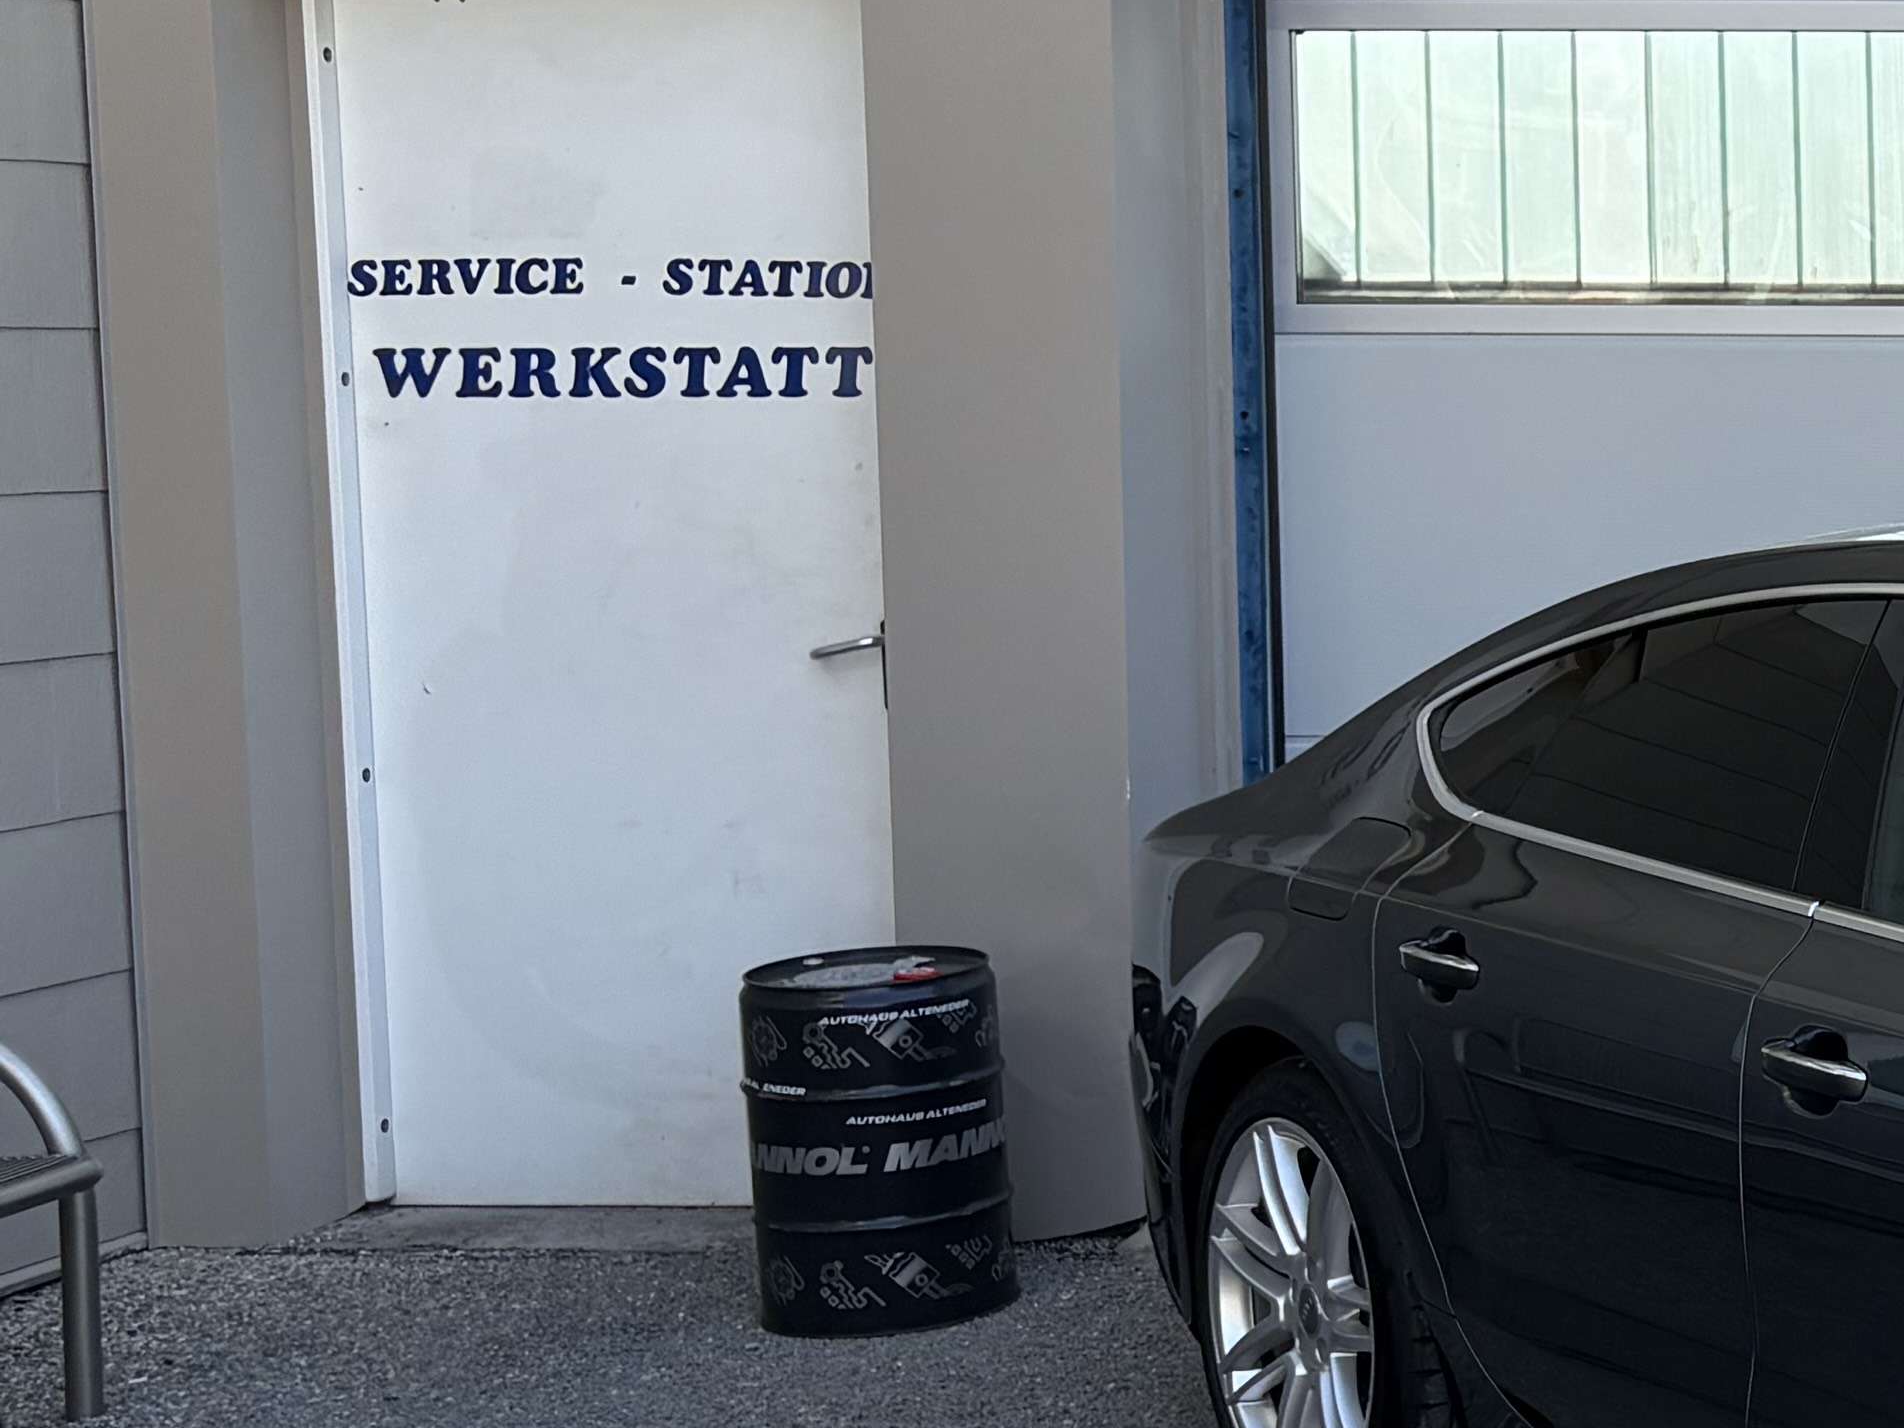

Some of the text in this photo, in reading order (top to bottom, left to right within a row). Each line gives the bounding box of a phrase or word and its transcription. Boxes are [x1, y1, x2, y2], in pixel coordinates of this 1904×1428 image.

[347, 257, 584, 298] SERVICE
[373, 346, 873, 398] WERKSTATT
[753, 1117, 1006, 1176] NNOL MANN
